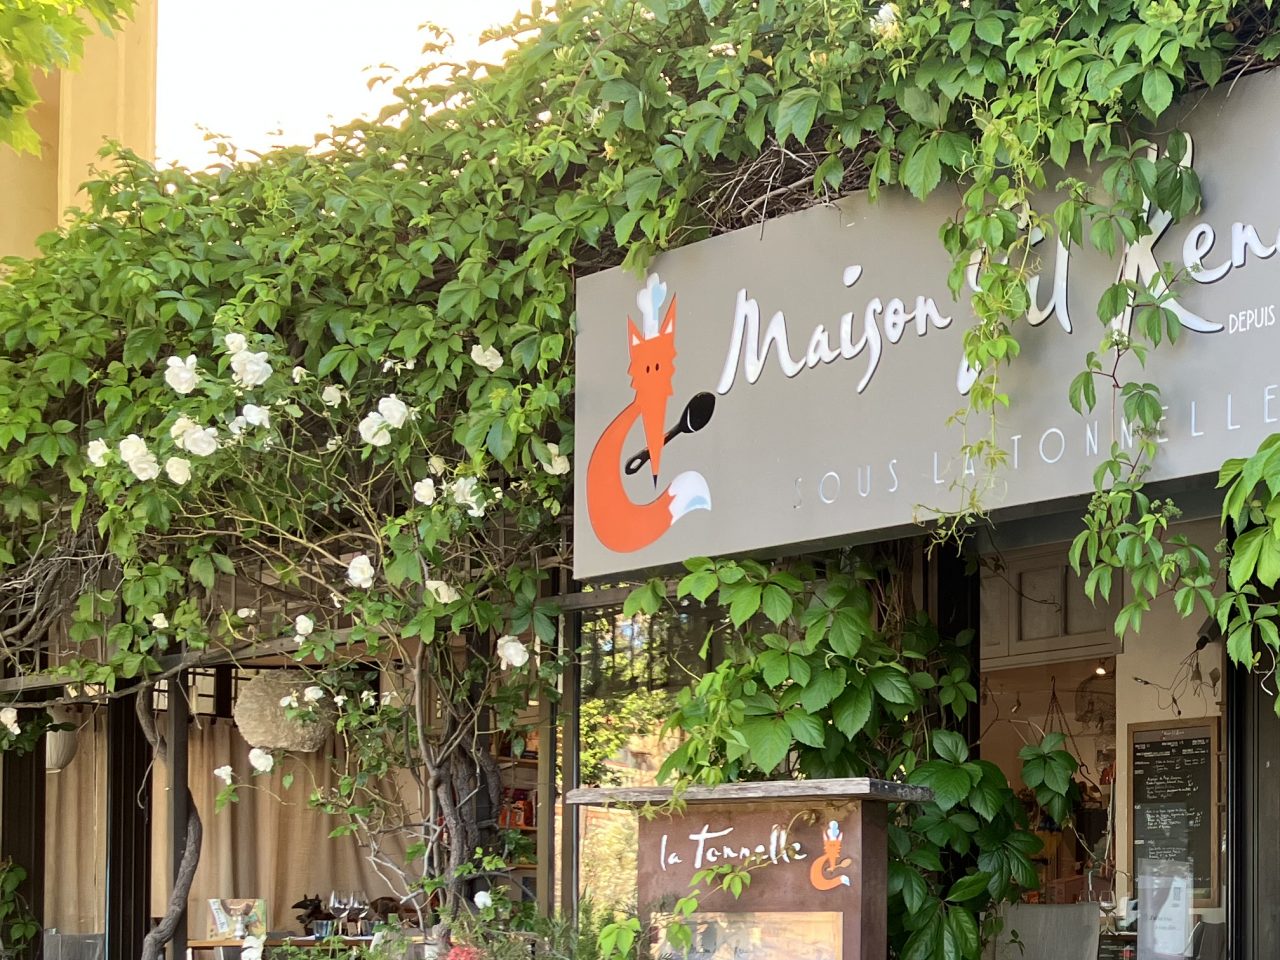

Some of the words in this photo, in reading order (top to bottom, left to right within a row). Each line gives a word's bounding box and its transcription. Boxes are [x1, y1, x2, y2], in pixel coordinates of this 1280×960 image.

[717, 264, 952, 396] Maison
[1229, 304, 1275, 334] DEPUIS
[793, 459, 899, 509] SOUS
[933, 446, 976, 484] LA
[1010, 384, 1279, 470] TONNELLE
[660, 835, 682, 871] la
[689, 824, 808, 869] Tonnelle
